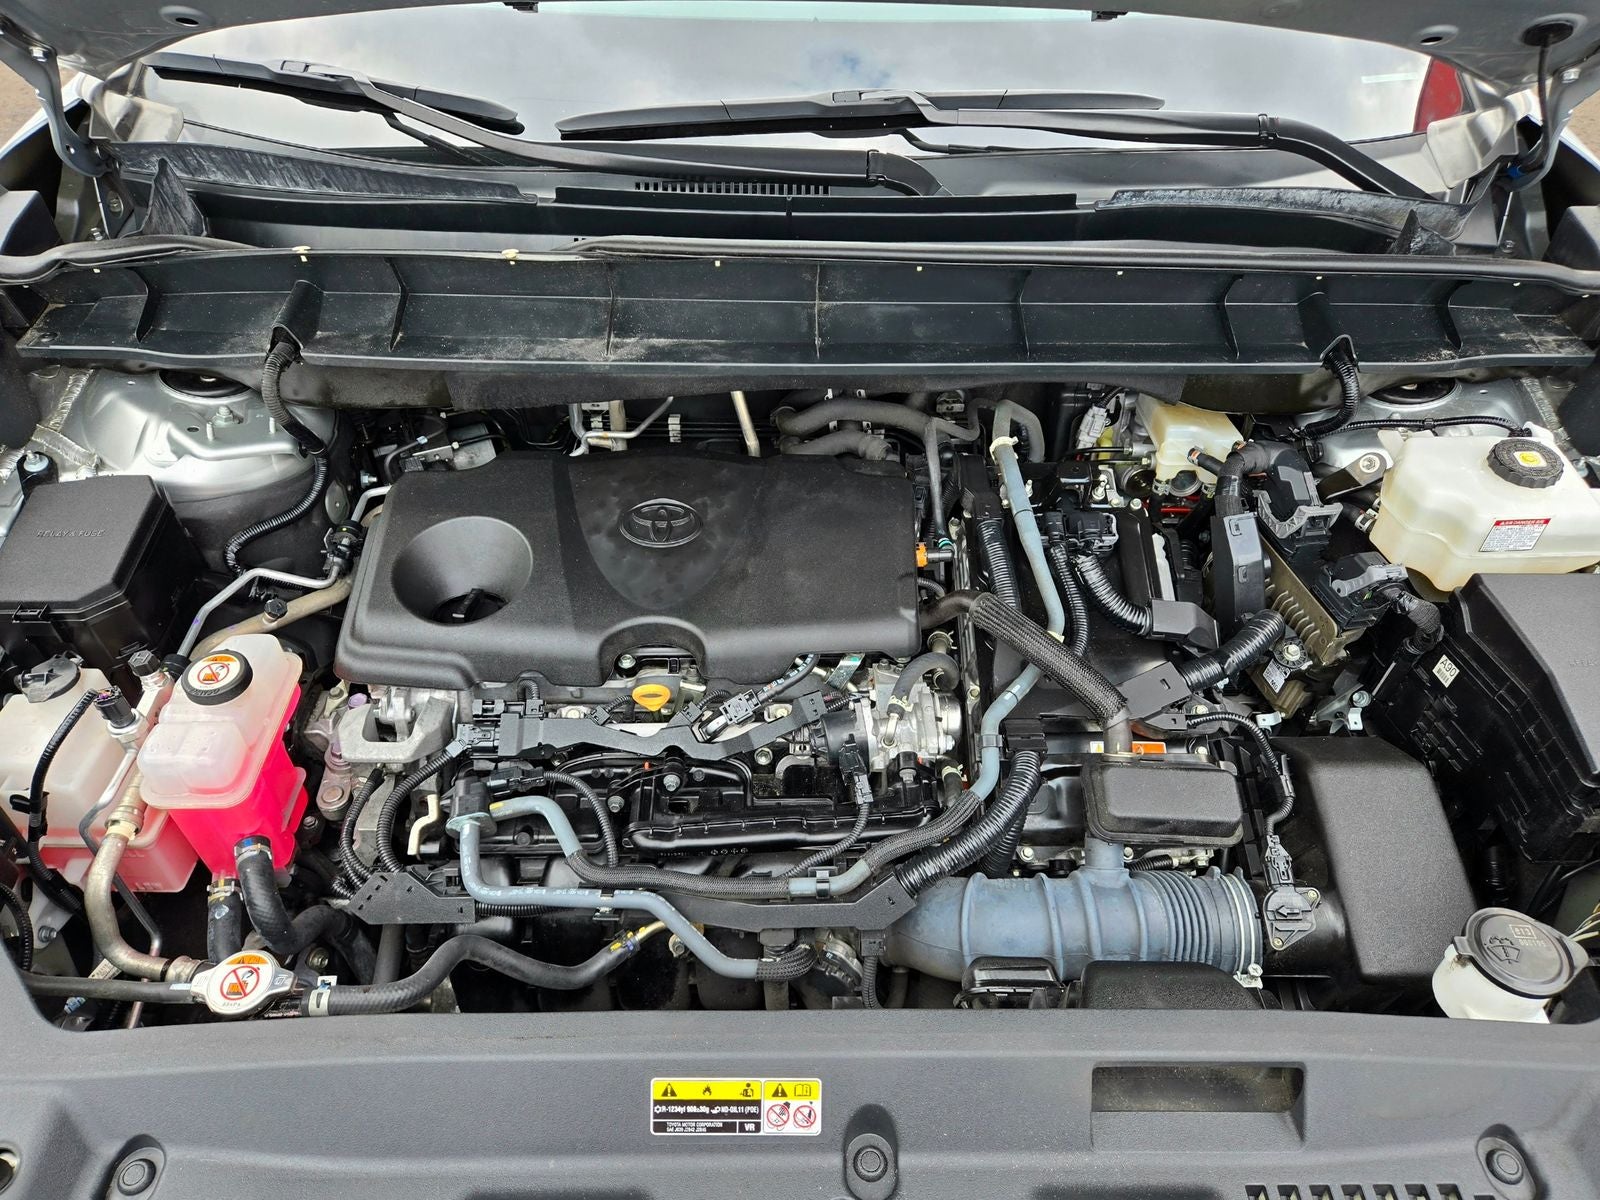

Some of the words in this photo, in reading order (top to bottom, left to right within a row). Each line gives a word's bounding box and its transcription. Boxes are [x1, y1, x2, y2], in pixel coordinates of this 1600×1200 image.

[79, 529, 106, 538] FUSE
[1440, 659, 1457, 677] A90
[744, 1123, 756, 1131] VR
